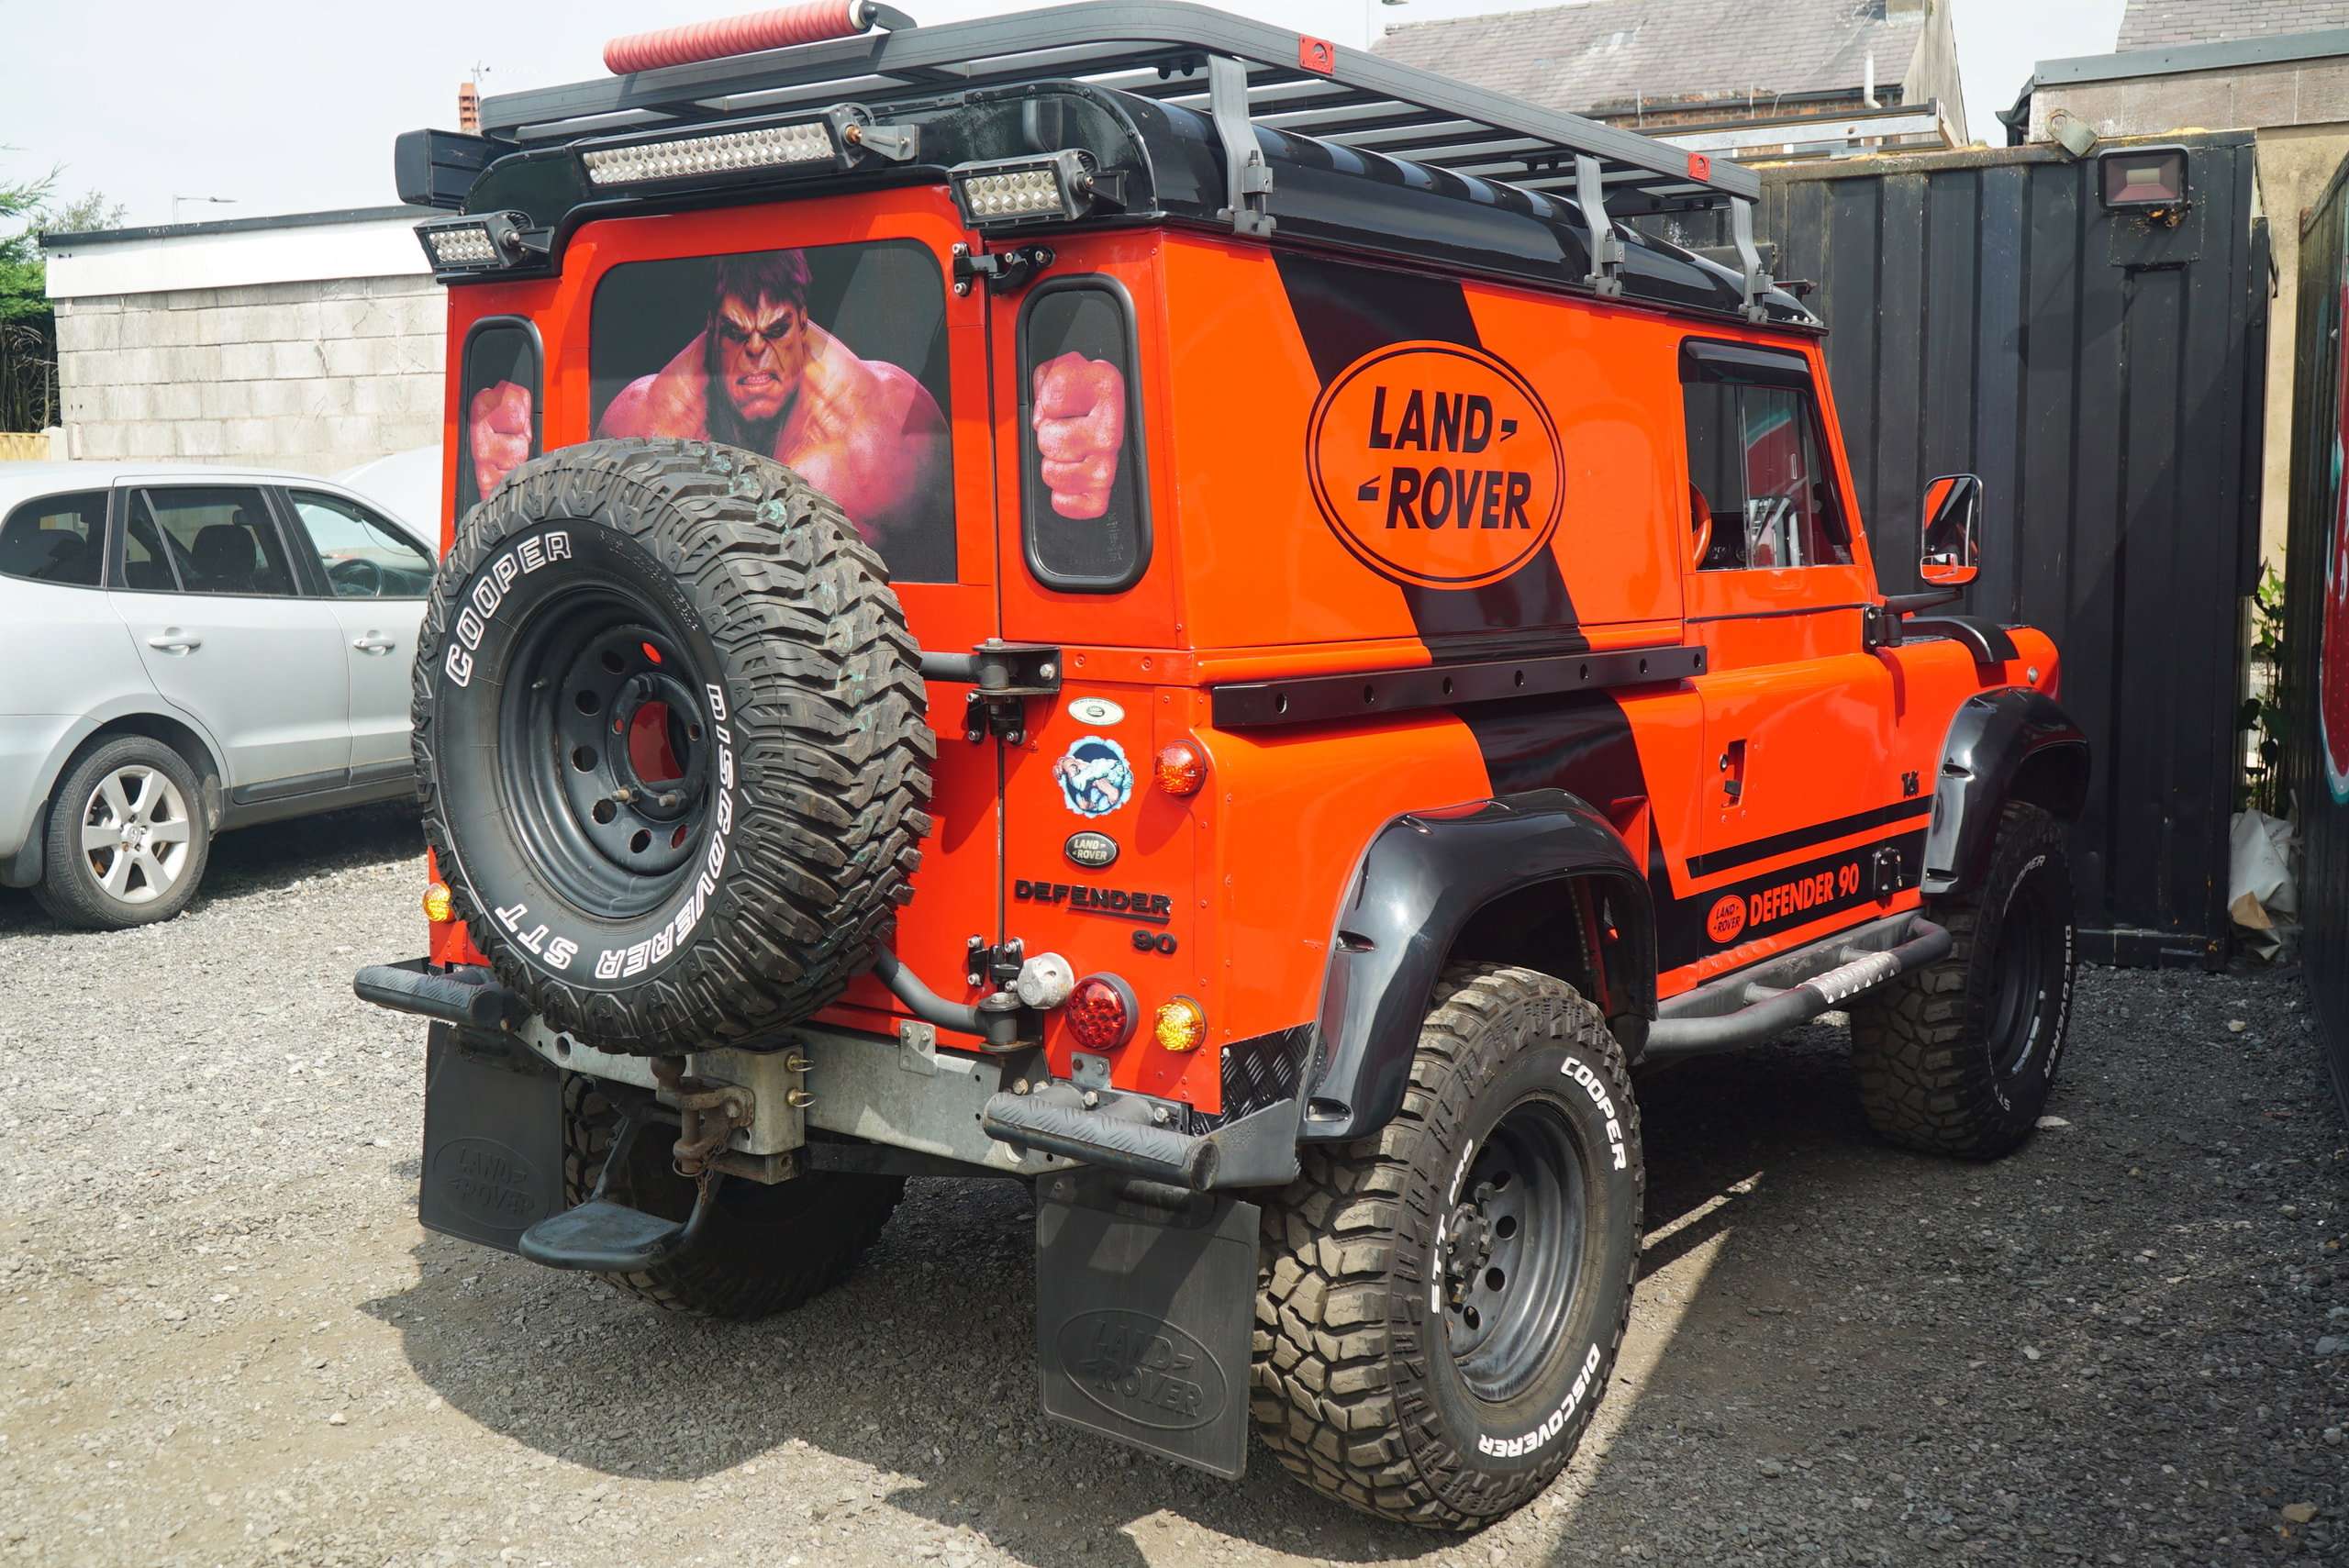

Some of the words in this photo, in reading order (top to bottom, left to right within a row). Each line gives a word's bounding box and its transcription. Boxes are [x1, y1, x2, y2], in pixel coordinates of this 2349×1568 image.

[1368, 385, 1493, 453] LAND
[1386, 466, 1531, 530] ROVER
[445, 530, 572, 687] COOPER
[595, 682, 734, 980] DISCOVERER
[1074, 838, 1100, 850] LAND
[1076, 849, 1108, 861] ROVER
[1014, 879, 1172, 915] DEFENDER
[1718, 916, 1741, 933] ROVER
[1749, 871, 1835, 927] DEFENDER
[1838, 862, 1860, 897] 90
[495, 903, 579, 970] STT
[1131, 929, 1177, 955] 90
[1560, 1056, 1627, 1171] COOPER
[1478, 1342, 1601, 1458] DISCOVERER
